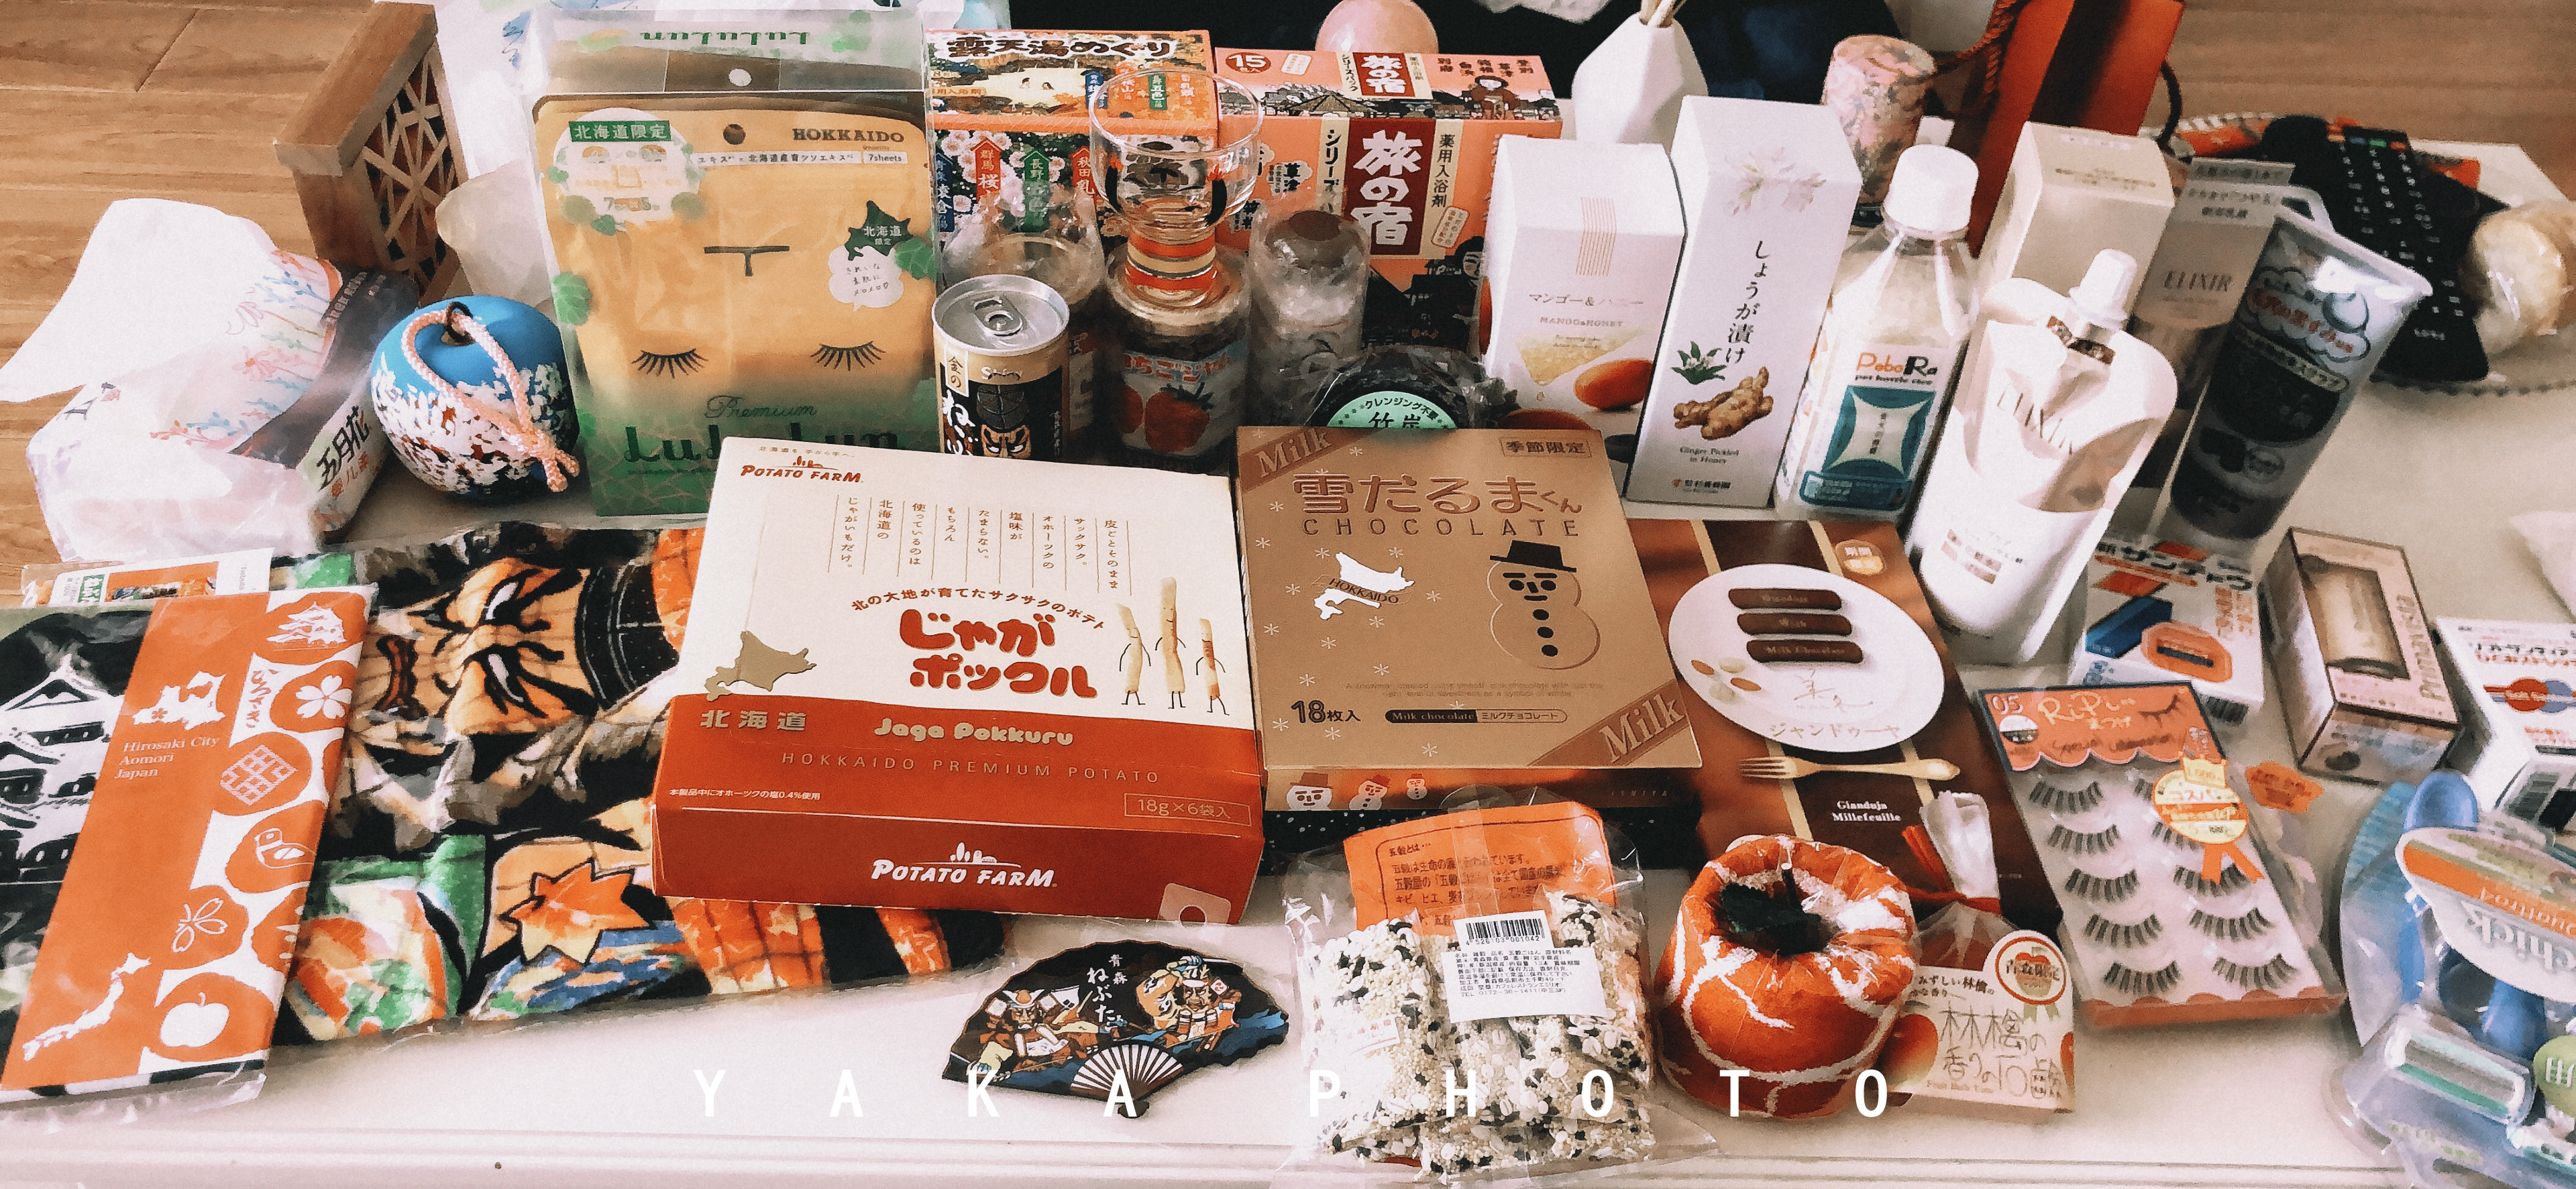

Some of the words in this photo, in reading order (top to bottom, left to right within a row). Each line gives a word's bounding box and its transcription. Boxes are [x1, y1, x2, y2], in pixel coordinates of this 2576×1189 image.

[947, 37, 1171, 57] 露天湯めぐり
[1228, 54, 1267, 68] 15
[1361, 55, 1408, 94] 旅の宿
[574, 123, 667, 140] 北海道限定
[792, 127, 905, 143] HOKKAIDO
[869, 154, 903, 163] 7sheets
[1432, 133, 1456, 209] 薬用入浴剤
[1350, 129, 1424, 247] 旅の宿
[863, 225, 902, 237] 北海道
[1725, 240, 1769, 365] しょうが漬け
[704, 395, 818, 419] Premium
[1364, 397, 1440, 420] クレンジング不要
[1256, 427, 1334, 478] Milk
[1505, 439, 1586, 455] 季節限定
[741, 464, 804, 478] POTATO
[810, 471, 863, 484] FARM
[1292, 472, 1582, 515] 雪だるまくん
[841, 497, 859, 568] じゃがいもだけ。
[877, 499, 894, 540] 北海道の
[909, 502, 926, 565] 使っているのは
[943, 506, 956, 543] もちろん
[1009, 512, 1024, 541] 塩味が
[1303, 517, 1579, 537] CHOCOLATE
[977, 510, 991, 559] たまらない。
[1042, 515, 1055, 569] オホーツクの
[1104, 519, 1118, 589] 皮ごとそのまま
[1329, 577, 1400, 605] HOKKAIDO
[899, 608, 1057, 657] じゃが
[910, 653, 1099, 699] ポックル
[699, 709, 809, 732] 北海道
[1291, 699, 1361, 724] 18枚入
[1481, 711, 1558, 720] ミルクチョコレート
[873, 716, 945, 742] Jaga
[954, 721, 1075, 746] Pokkuru
[1597, 691, 1686, 764] Milk
[123, 739, 186, 752] Hirosaki
[190, 736, 221, 749] City
[118, 752, 176, 766] Aomori
[781, 751, 916, 771] HOKKAIDO
[932, 759, 1052, 777] PREMIUM
[1068, 766, 1160, 784] POTATO
[113, 768, 160, 780] Japan
[1831, 811, 1902, 823] Millefeuille
[1836, 800, 1888, 811] Gianduja
[870, 858, 968, 885] POTATO
[977, 866, 1055, 889] FARM
[1108, 954, 1128, 986] 青森
[1086, 966, 1124, 1023] ねぶた
